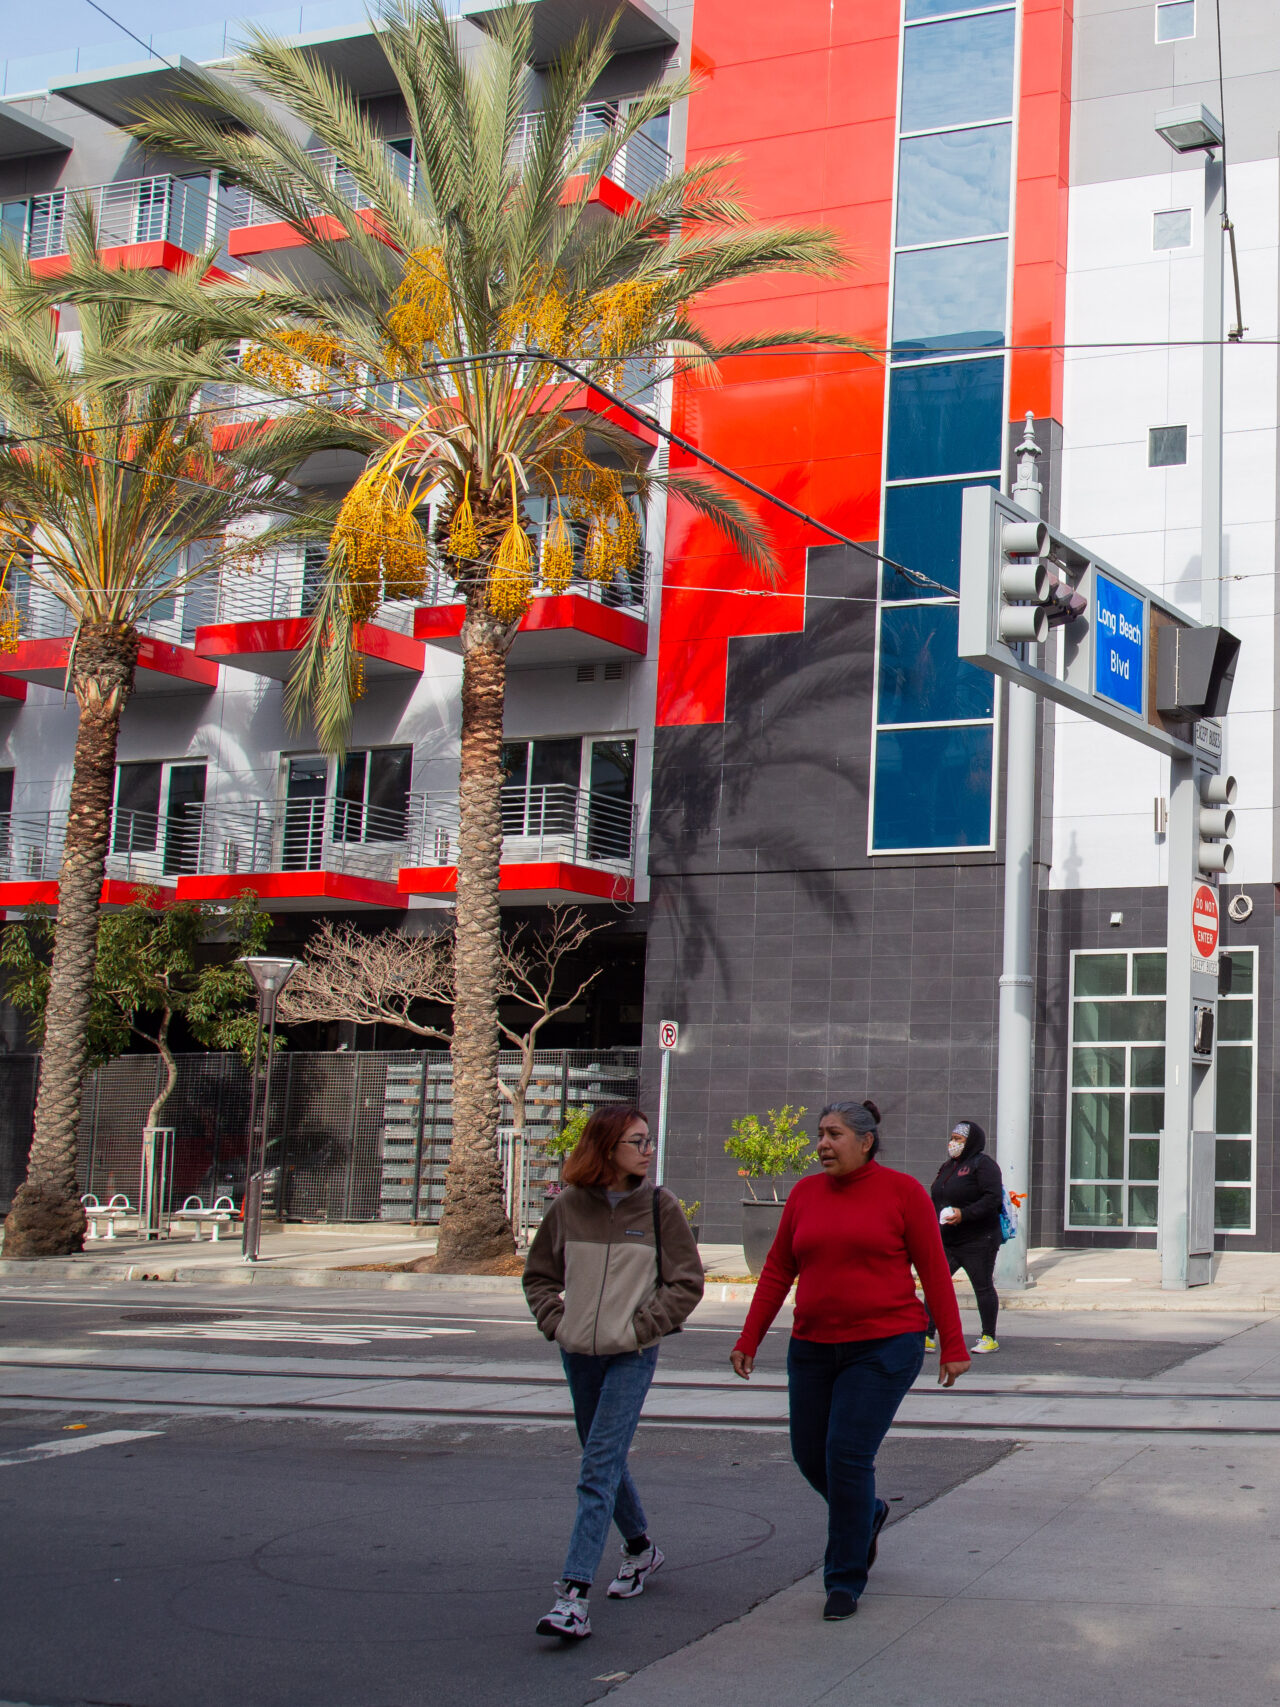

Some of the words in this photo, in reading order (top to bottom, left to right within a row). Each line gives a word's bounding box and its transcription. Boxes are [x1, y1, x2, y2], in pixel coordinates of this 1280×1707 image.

[1097, 600, 1117, 635] Long
[1119, 613, 1142, 646] Beach
[1110, 649, 1130, 680] Blvd
[1196, 898, 1203, 911] DO
[1204, 900, 1216, 913] NOT
[1197, 930, 1213, 945] ENTER
